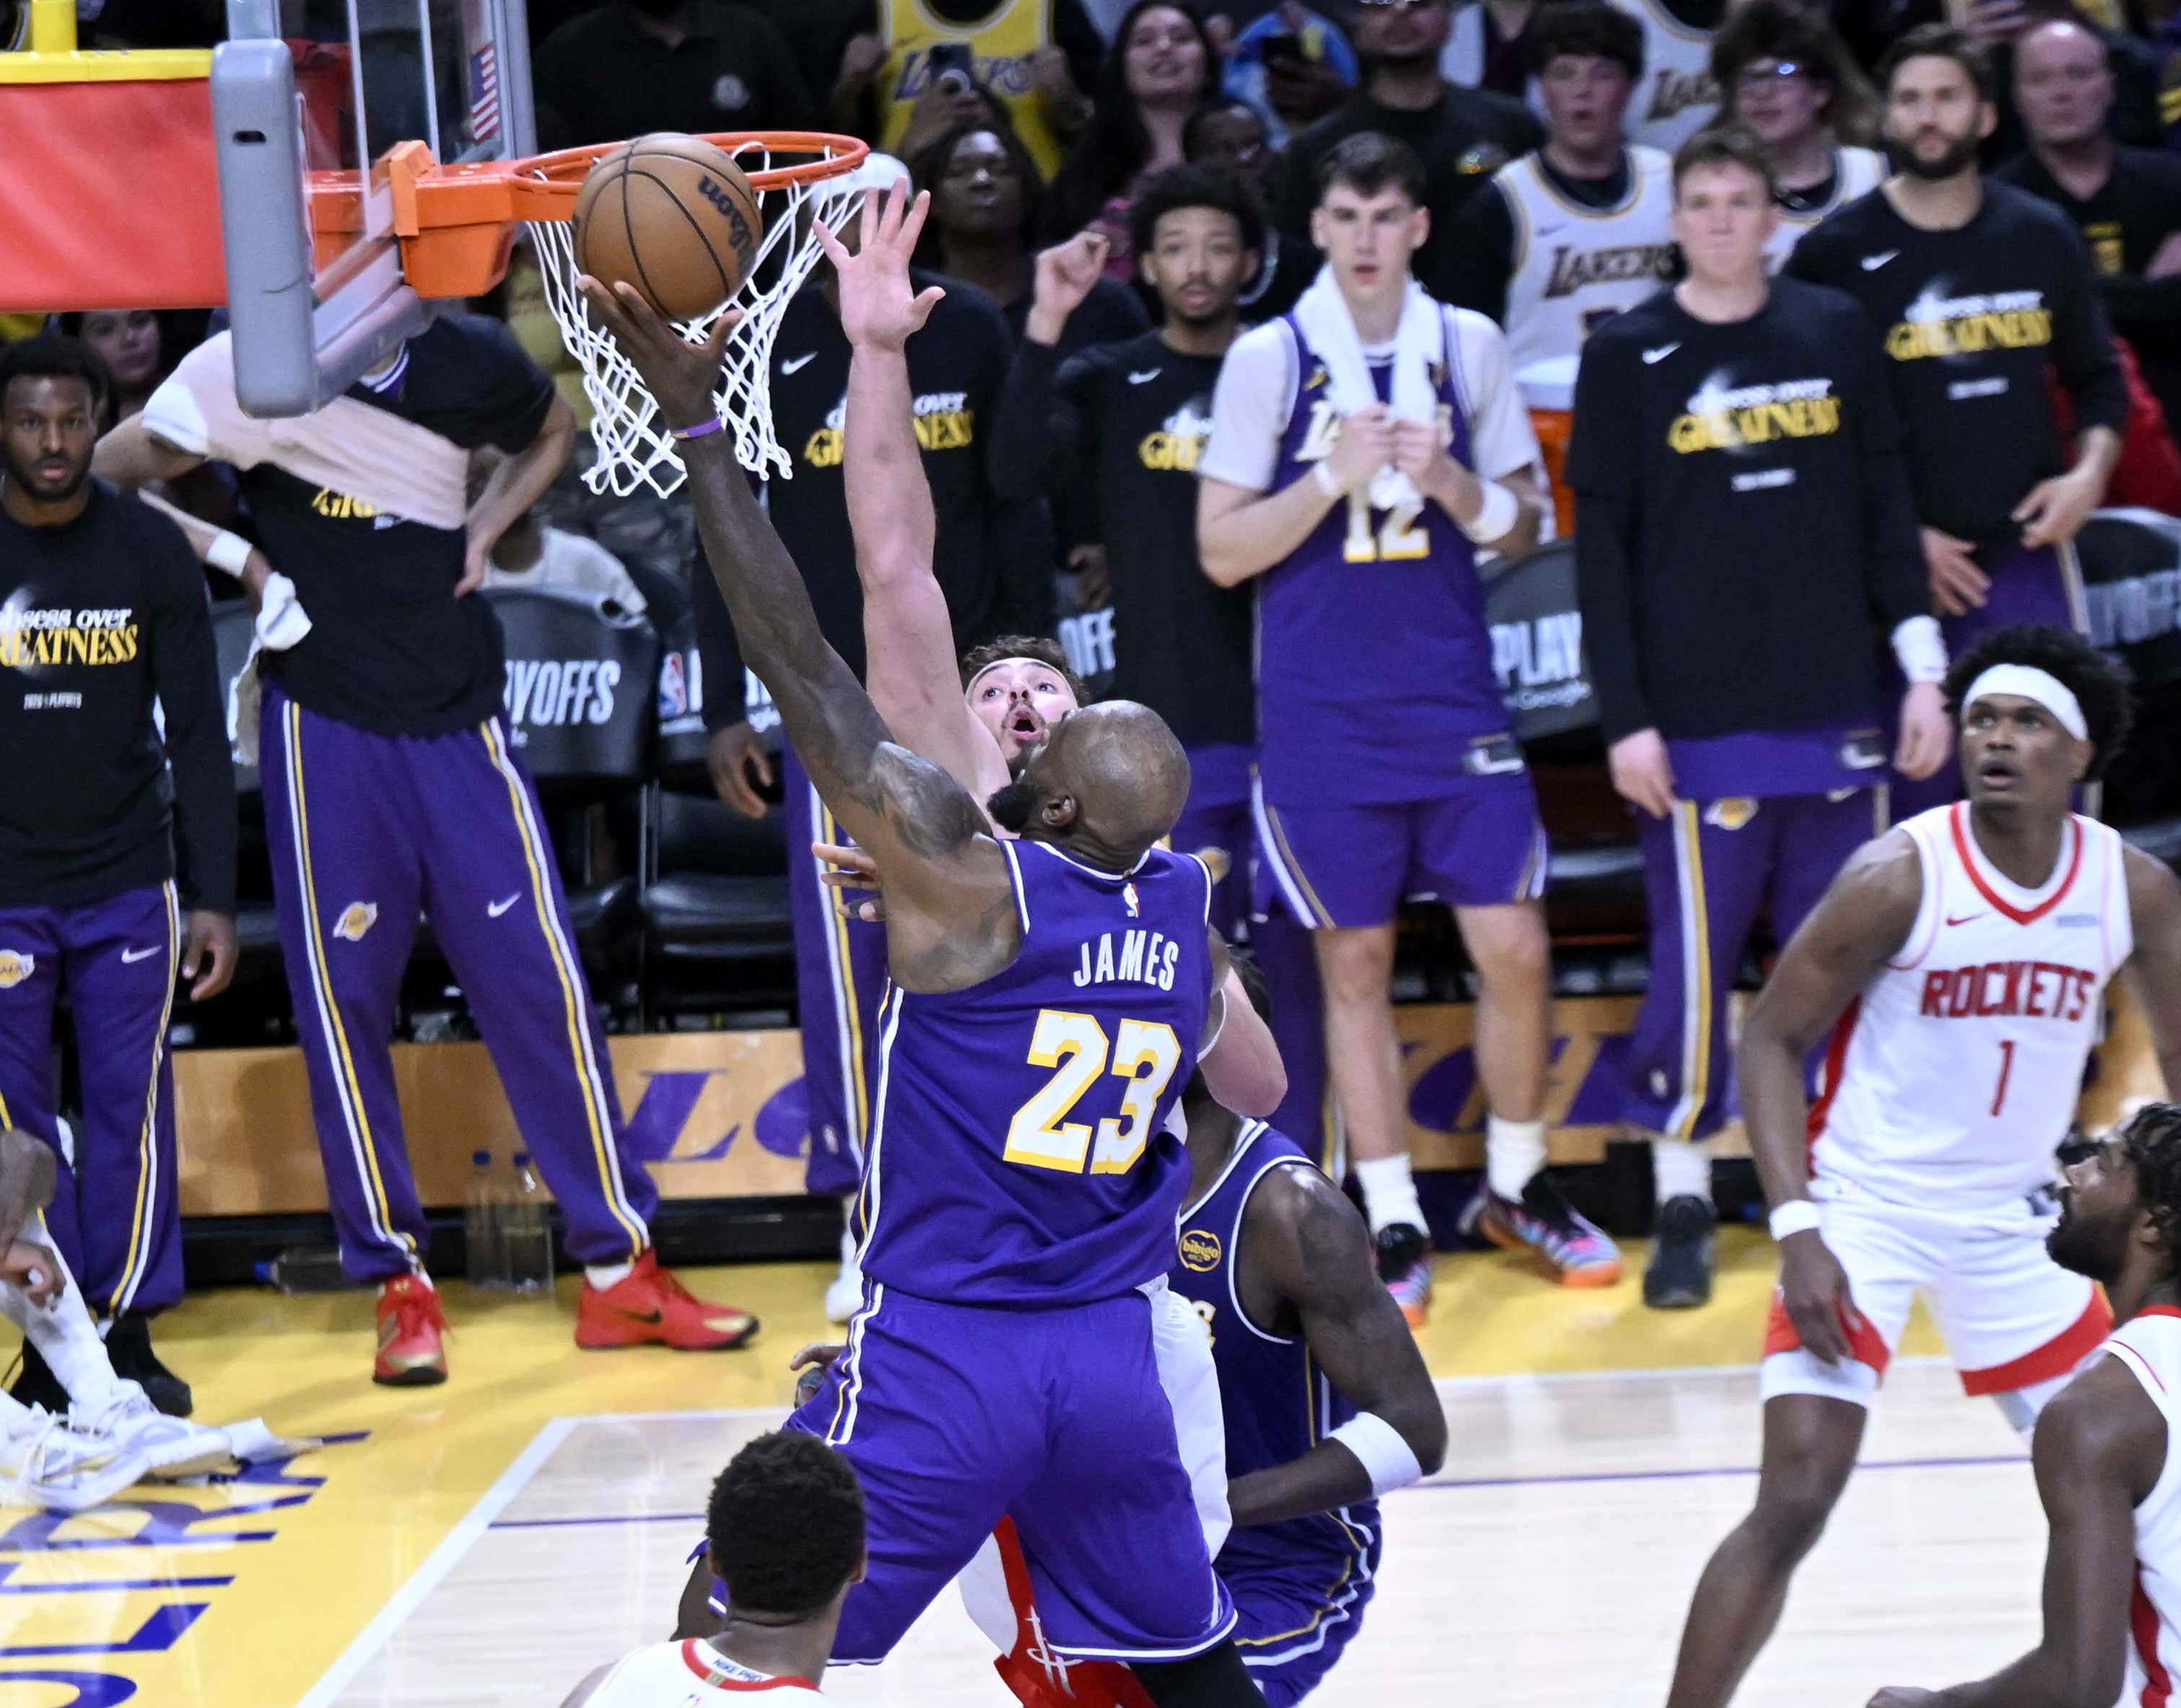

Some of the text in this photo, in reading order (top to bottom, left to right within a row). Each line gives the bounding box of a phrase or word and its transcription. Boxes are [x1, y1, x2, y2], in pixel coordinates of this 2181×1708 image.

[76, 609, 133, 630] over
[503, 659, 621, 725] YOFFS
[1074, 929, 1180, 991] JAMES
[1921, 961, 2096, 1022] ROCKETS
[1003, 1009, 1182, 1175] 23
[1989, 1040, 2017, 1117] 1
[1182, 1238, 1219, 1262] bibigo
[712, 1658, 739, 1673] NIKE
